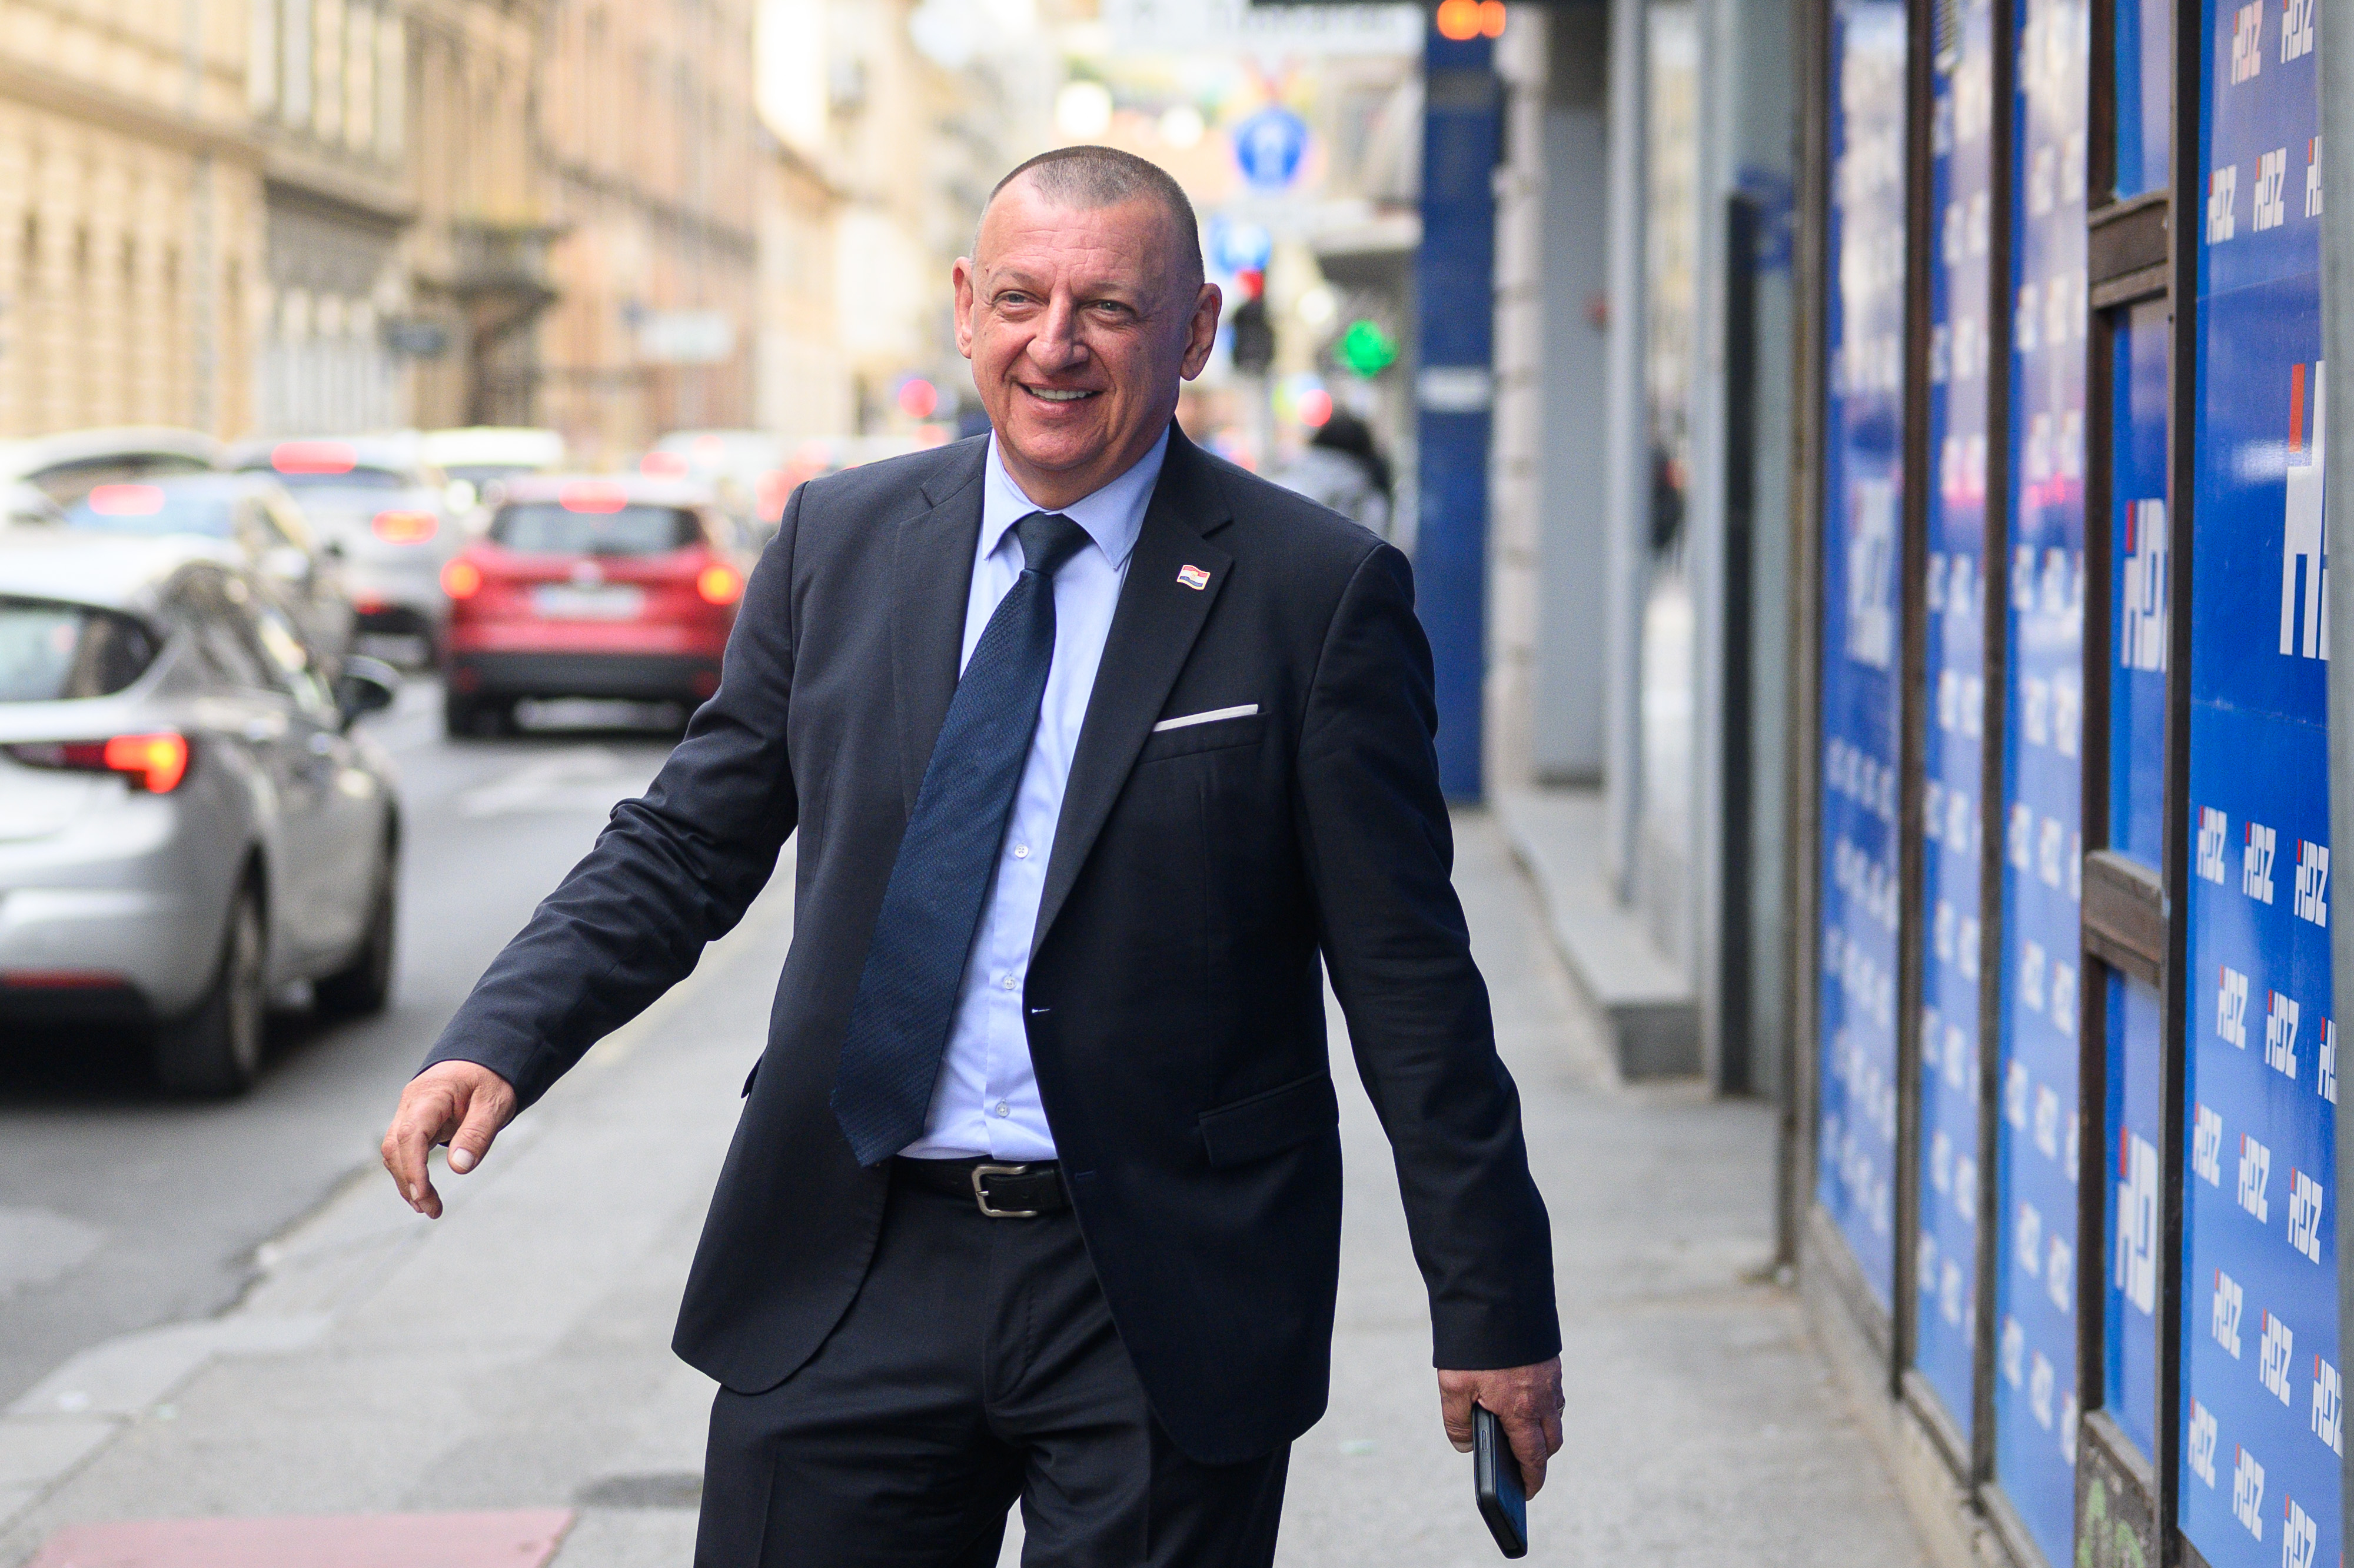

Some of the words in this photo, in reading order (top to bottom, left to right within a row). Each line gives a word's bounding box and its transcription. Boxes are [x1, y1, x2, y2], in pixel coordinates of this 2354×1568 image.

[2230, 0, 2264, 85] HDZ
[2280, 0, 2313, 64] HDZ
[2206, 164, 2237, 245] HDZ
[2253, 147, 2287, 232] HDZ
[2122, 498, 2167, 673] HD
[2196, 805, 2227, 885] HDZ
[2243, 821, 2276, 905] HDZ
[2294, 838, 2330, 928] HDZ
[2216, 964, 2249, 1050] HDZ
[2265, 989, 2300, 1080] HDZ
[2192, 1101, 2223, 1189] HDZ
[2237, 1132, 2271, 1224] HDZ
[2115, 1125, 2159, 1316] HD
[2287, 1167, 2323, 1265] HDZ
[2212, 1267, 2243, 1361] HDZ
[2259, 1308, 2293, 1408] HDZ
[2187, 1396, 2218, 1490] HDZ
[2232, 1443, 2265, 1543] HDZ
[2282, 1493, 2317, 1568] HDZ
